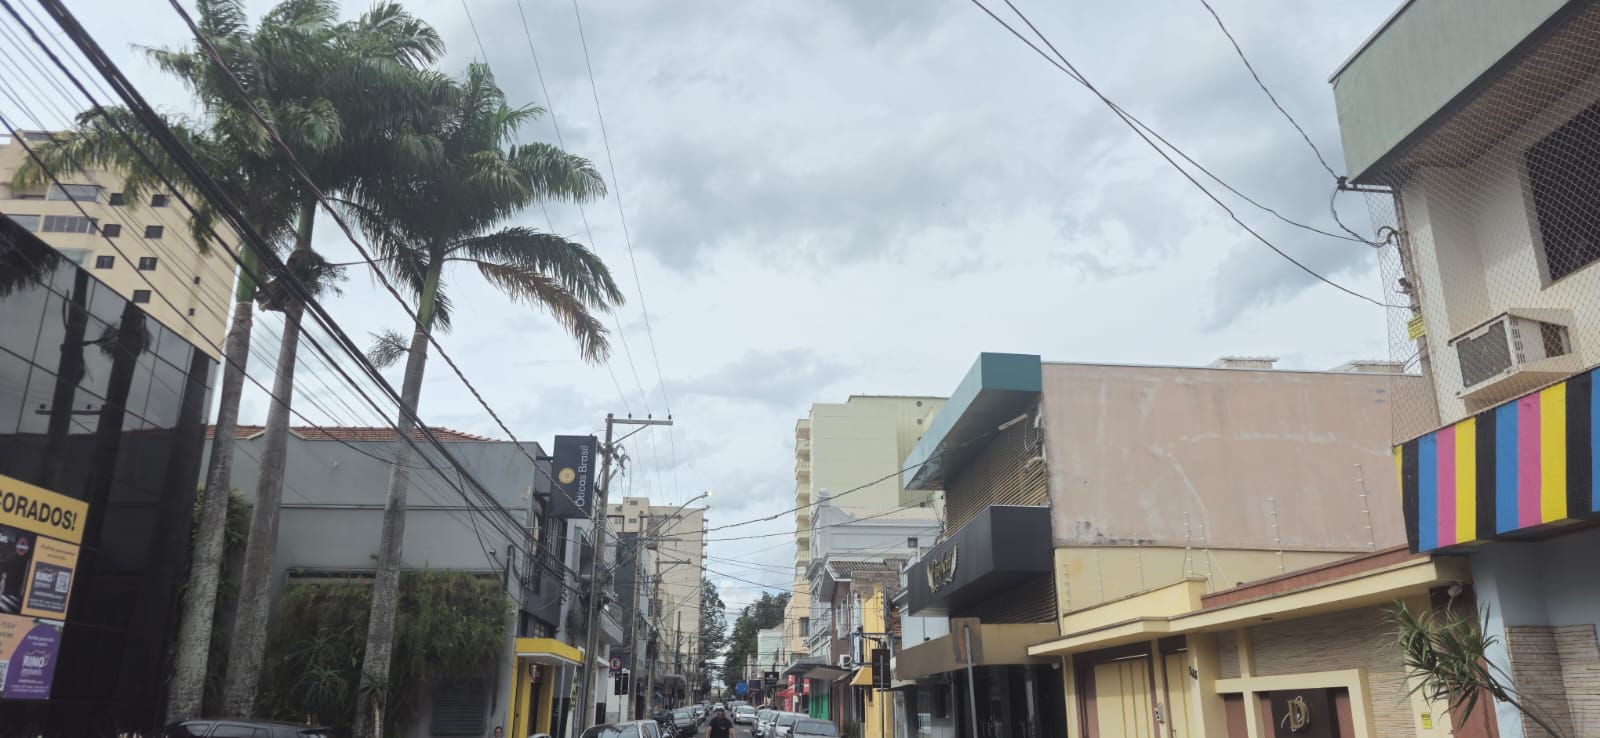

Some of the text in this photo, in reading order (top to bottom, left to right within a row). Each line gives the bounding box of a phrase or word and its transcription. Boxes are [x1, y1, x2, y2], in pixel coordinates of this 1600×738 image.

[578, 446, 590, 473] Brasil
[0, 489, 77, 531] ORADOS!
[23, 655, 45, 668] RINO
